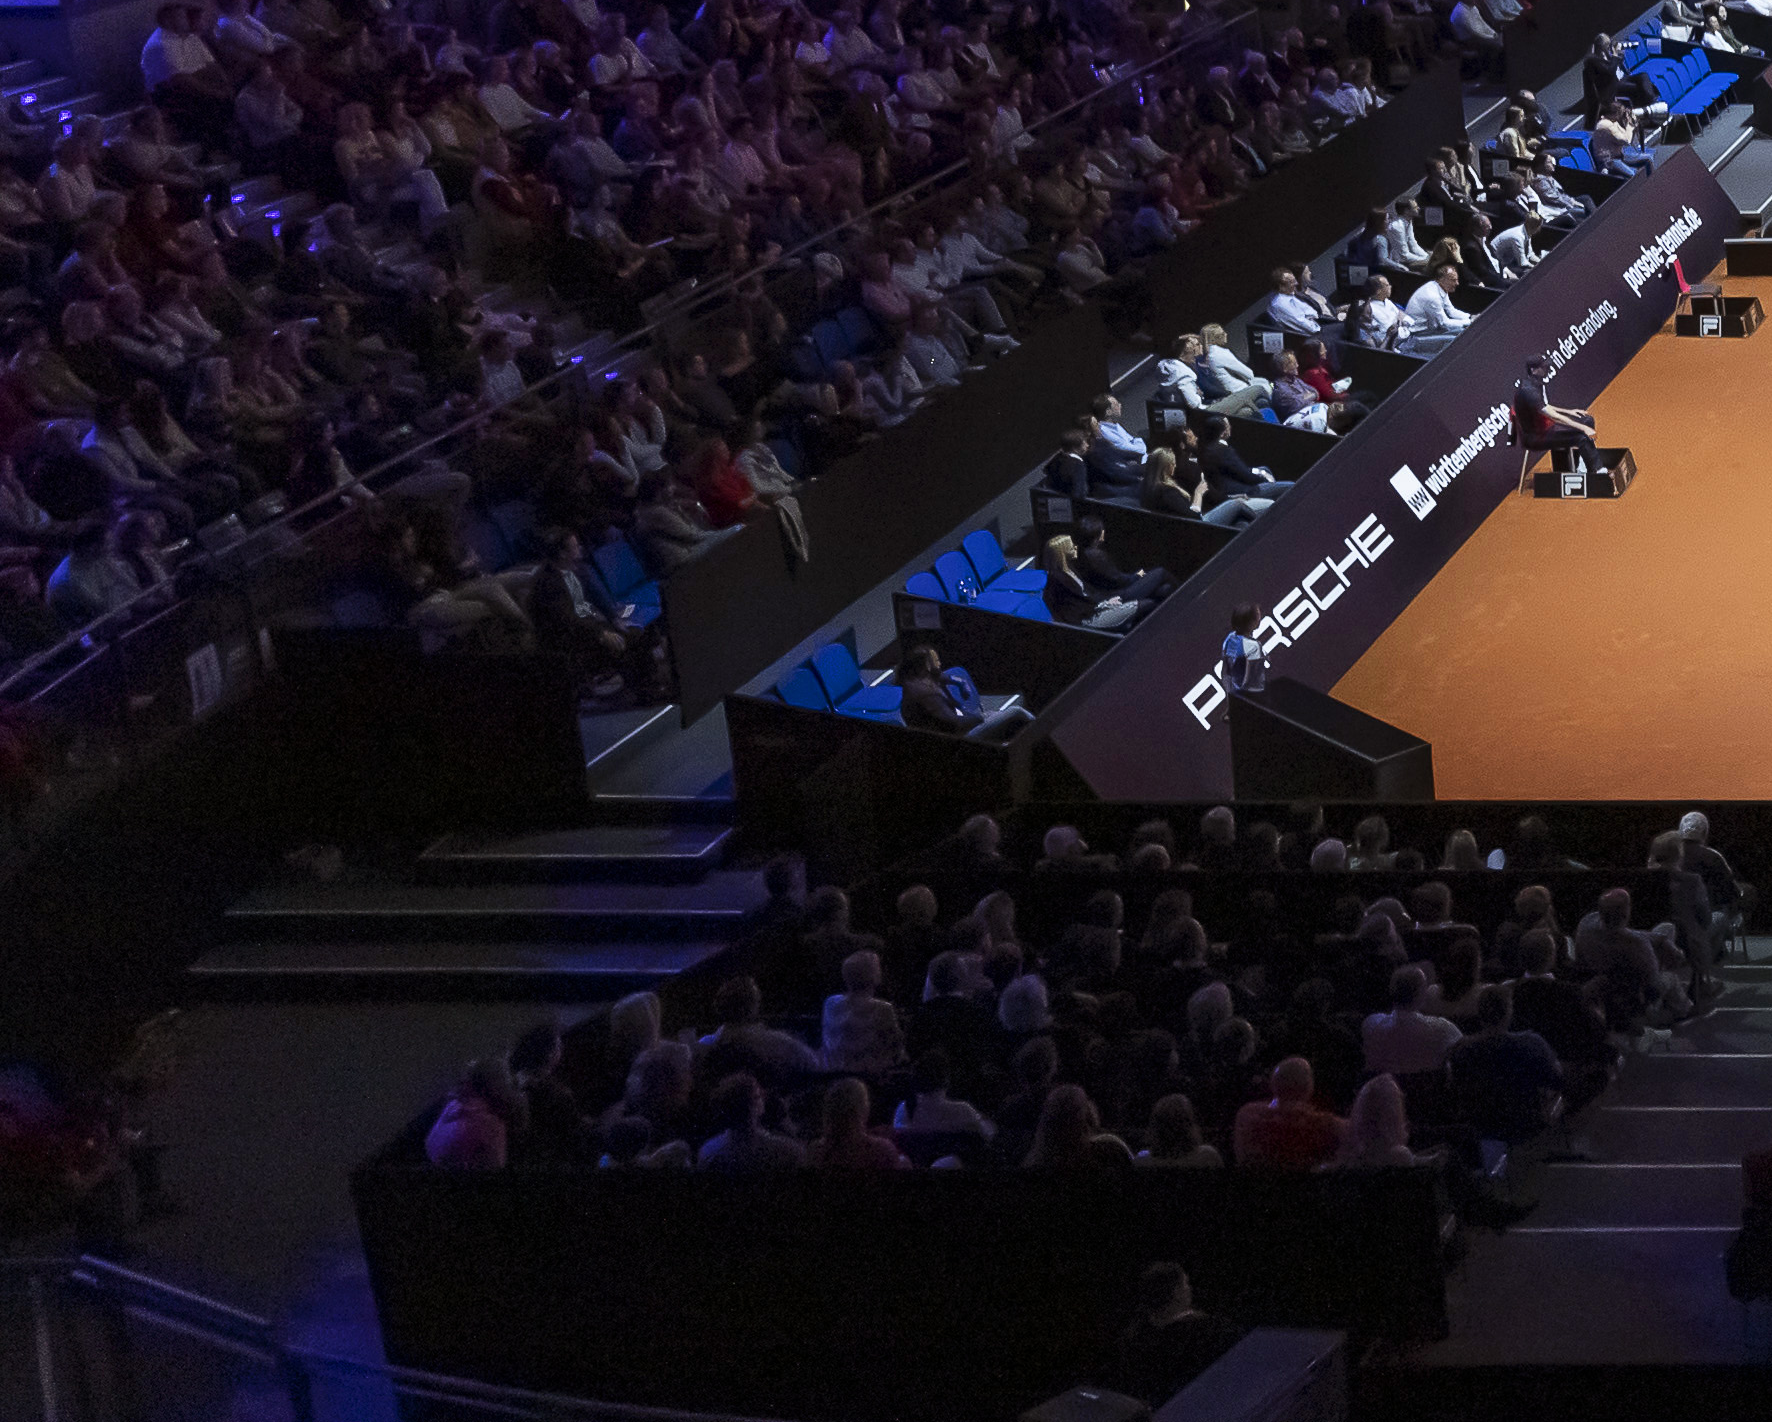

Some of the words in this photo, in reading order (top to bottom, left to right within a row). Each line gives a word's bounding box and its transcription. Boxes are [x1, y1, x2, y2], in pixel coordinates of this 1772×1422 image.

[1623, 205, 1702, 298] porsche-tennis.de
[1547, 348, 1566, 370] in
[1557, 332, 1579, 360] der
[1569, 299, 1617, 346] Brandung.
[1425, 402, 1510, 496] württembergische
[1182, 512, 1395, 731] PRSCHE
